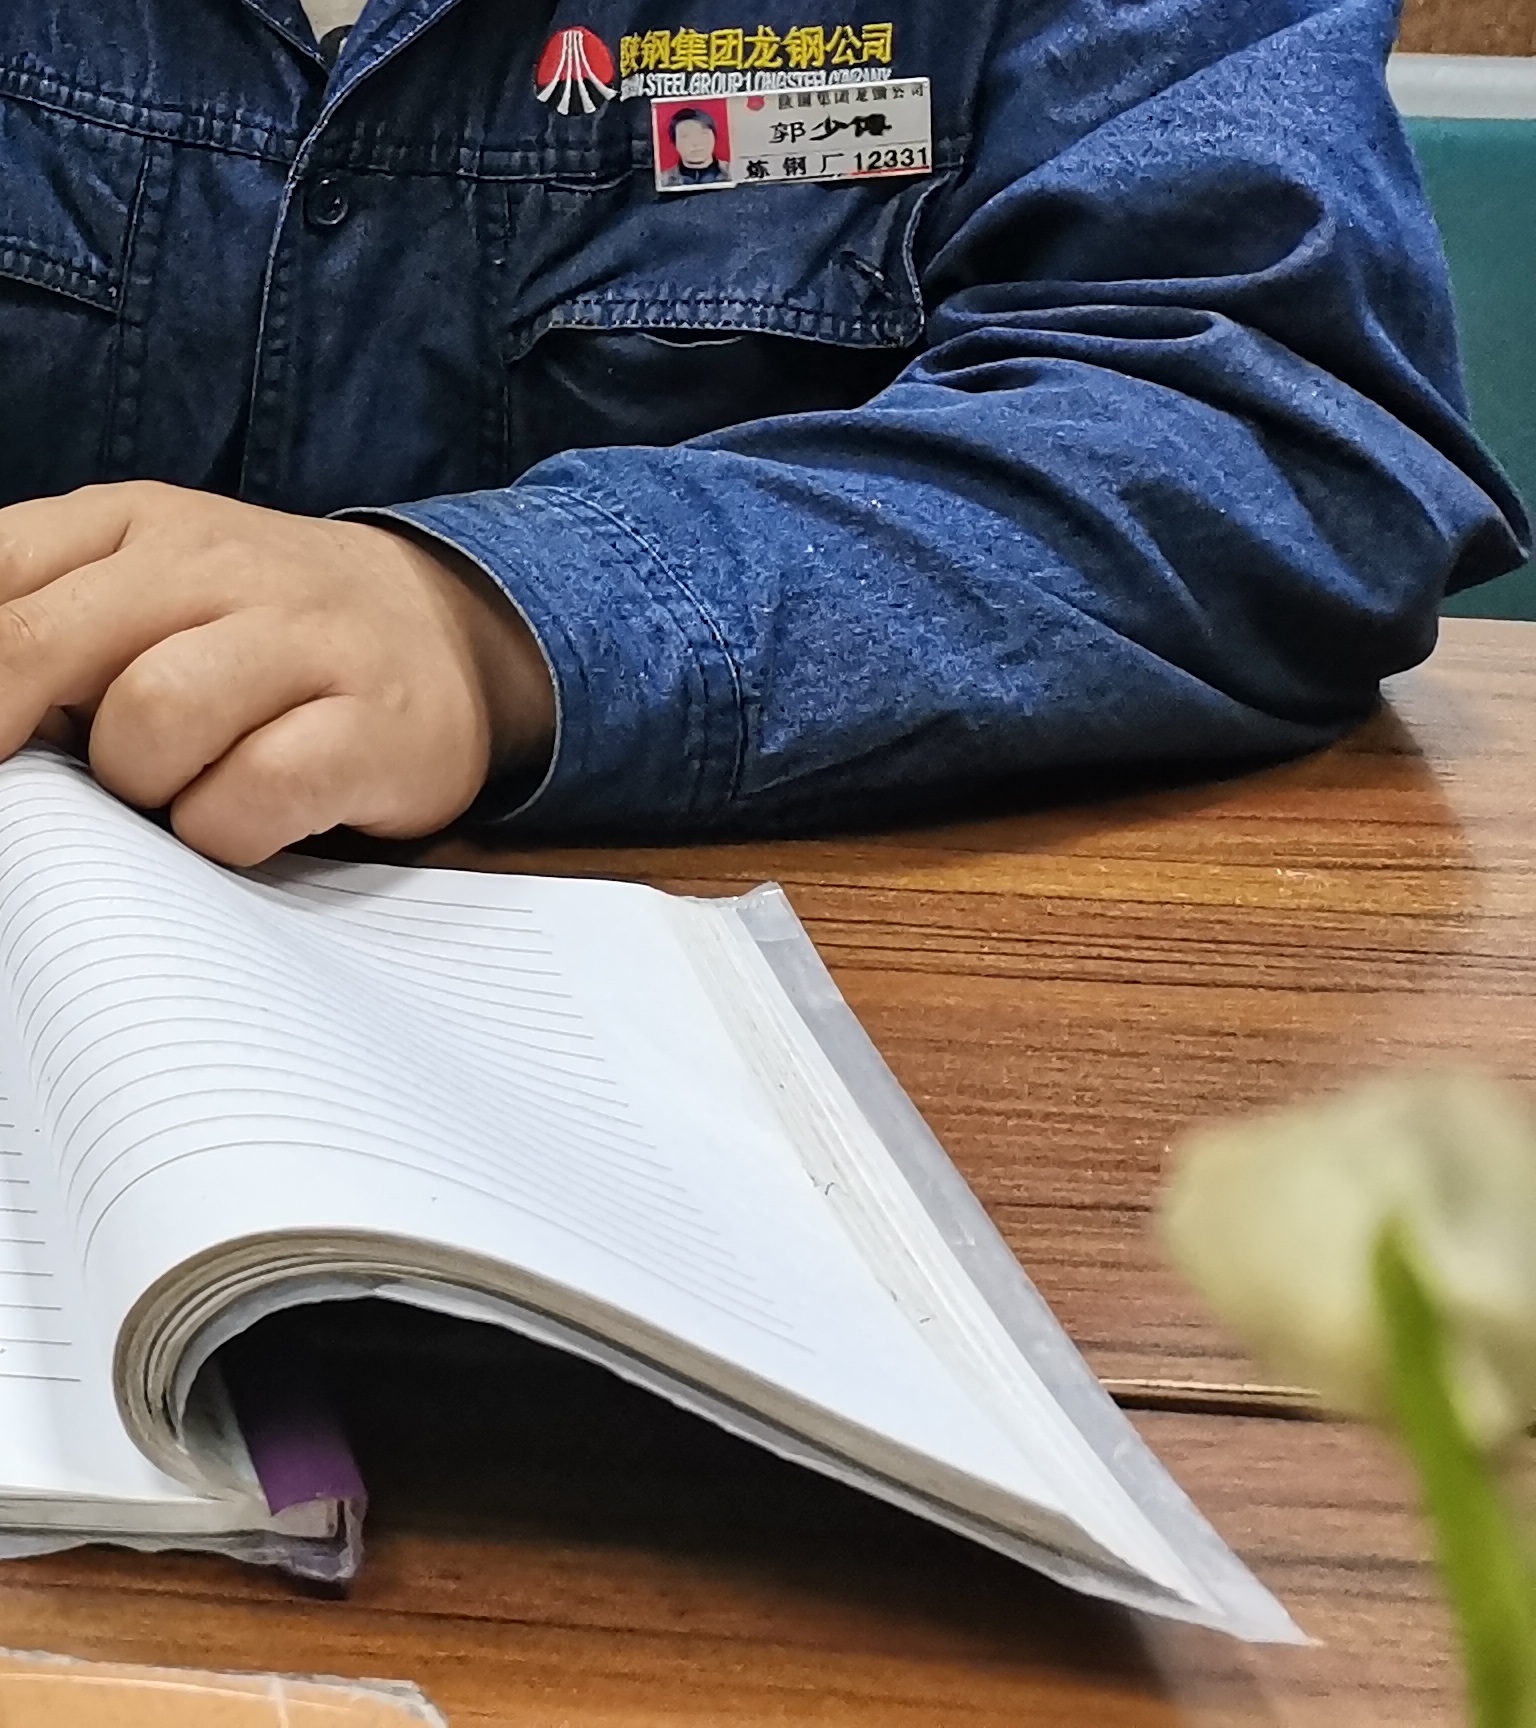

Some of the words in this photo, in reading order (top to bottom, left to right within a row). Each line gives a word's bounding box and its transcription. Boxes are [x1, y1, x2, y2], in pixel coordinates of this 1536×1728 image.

[620, 22, 894, 75] 陕钢集团龙钢公司
